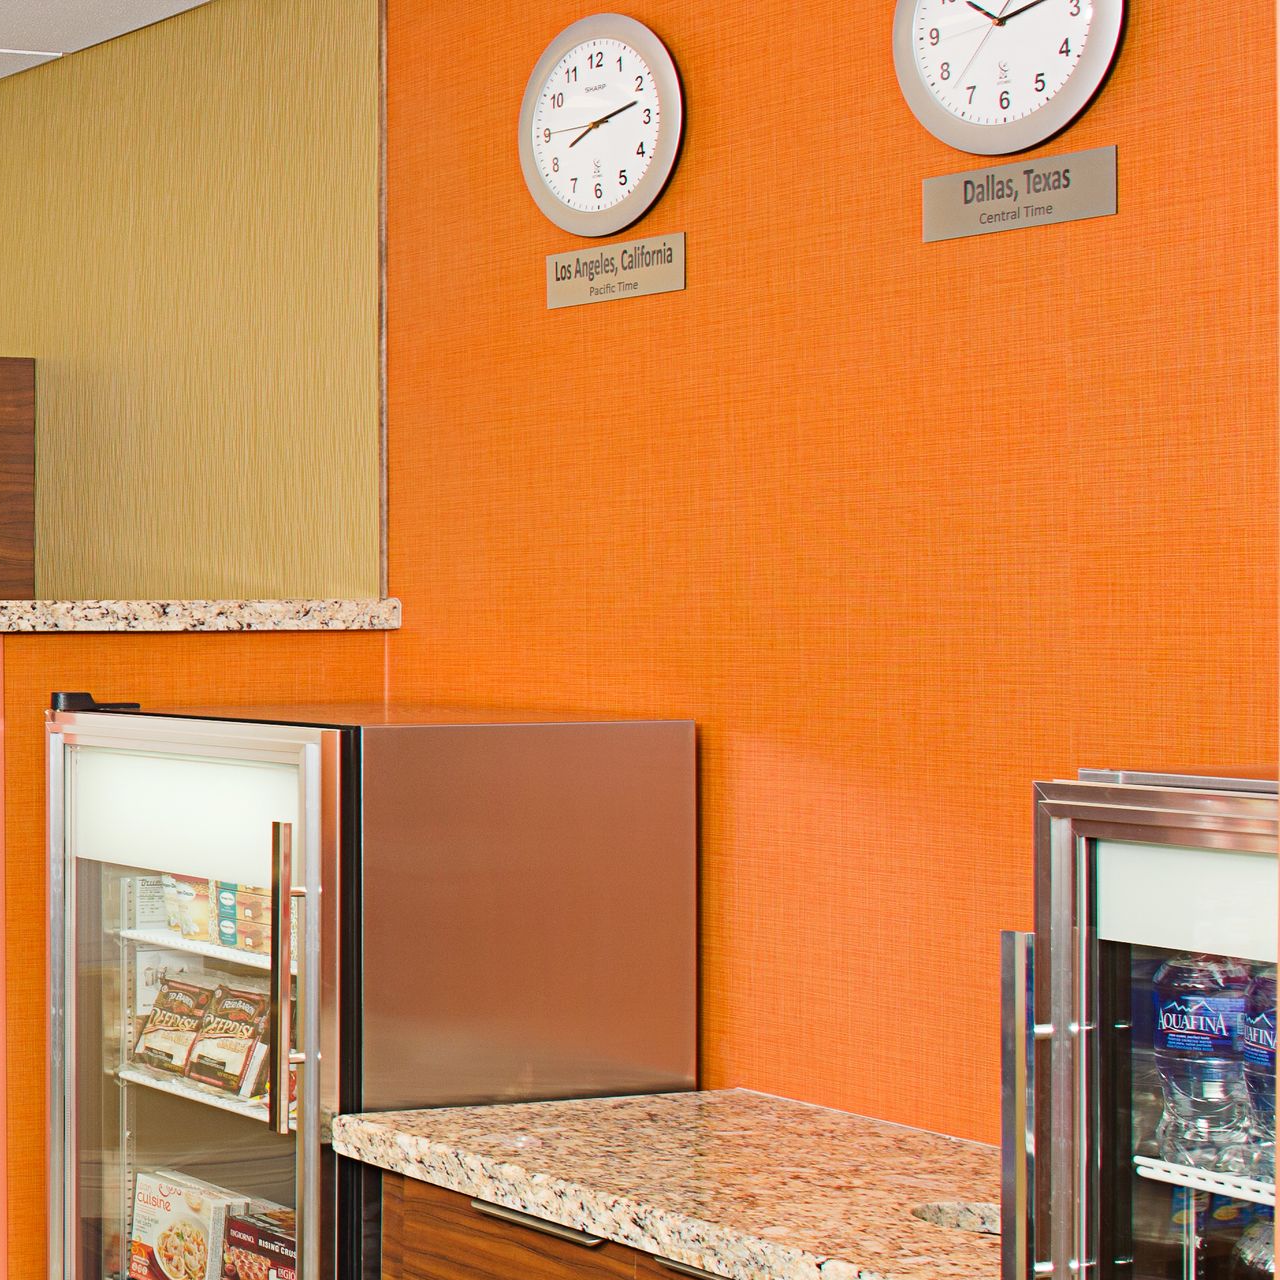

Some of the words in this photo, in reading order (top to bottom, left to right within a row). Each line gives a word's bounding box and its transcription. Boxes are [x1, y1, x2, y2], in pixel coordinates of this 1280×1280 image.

[929, 28, 940, 46] 9
[1059, 37, 1071, 57] 4
[587, 51, 604, 69] 12
[617, 56, 623, 72] 1
[565, 66, 577, 83] 11
[940, 62, 950, 81] 8
[584, 83, 607, 93] SHARP
[635, 75, 644, 92] 2
[1034, 72, 1046, 92] 5
[550, 92, 564, 109] 10
[966, 85, 977, 105] 7
[999, 90, 1010, 110] 6
[643, 108, 651, 124] 3
[544, 128, 551, 143] 9
[636, 141, 645, 157] 4
[552, 157, 559, 173] 8
[570, 177, 578, 193] 7
[618, 169, 627, 185] 5
[594, 183, 602, 199] 6
[963, 174, 1019, 205] Dallas,
[1023, 168, 1071, 195] Texas
[979, 207, 1021, 225] Central
[1023, 203, 1053, 219] Time
[555, 261, 571, 281] Los
[574, 252, 618, 281] Angeles,
[621, 242, 673, 271] California
[589, 283, 615, 296] Pacific
[617, 281, 639, 292] Time
[1157, 1007, 1229, 1037] AQUAFINA
[137, 1191, 171, 1213] cuisine
[258, 1238, 280, 1253] RISING
[280, 1246, 296, 1259] CRUS
